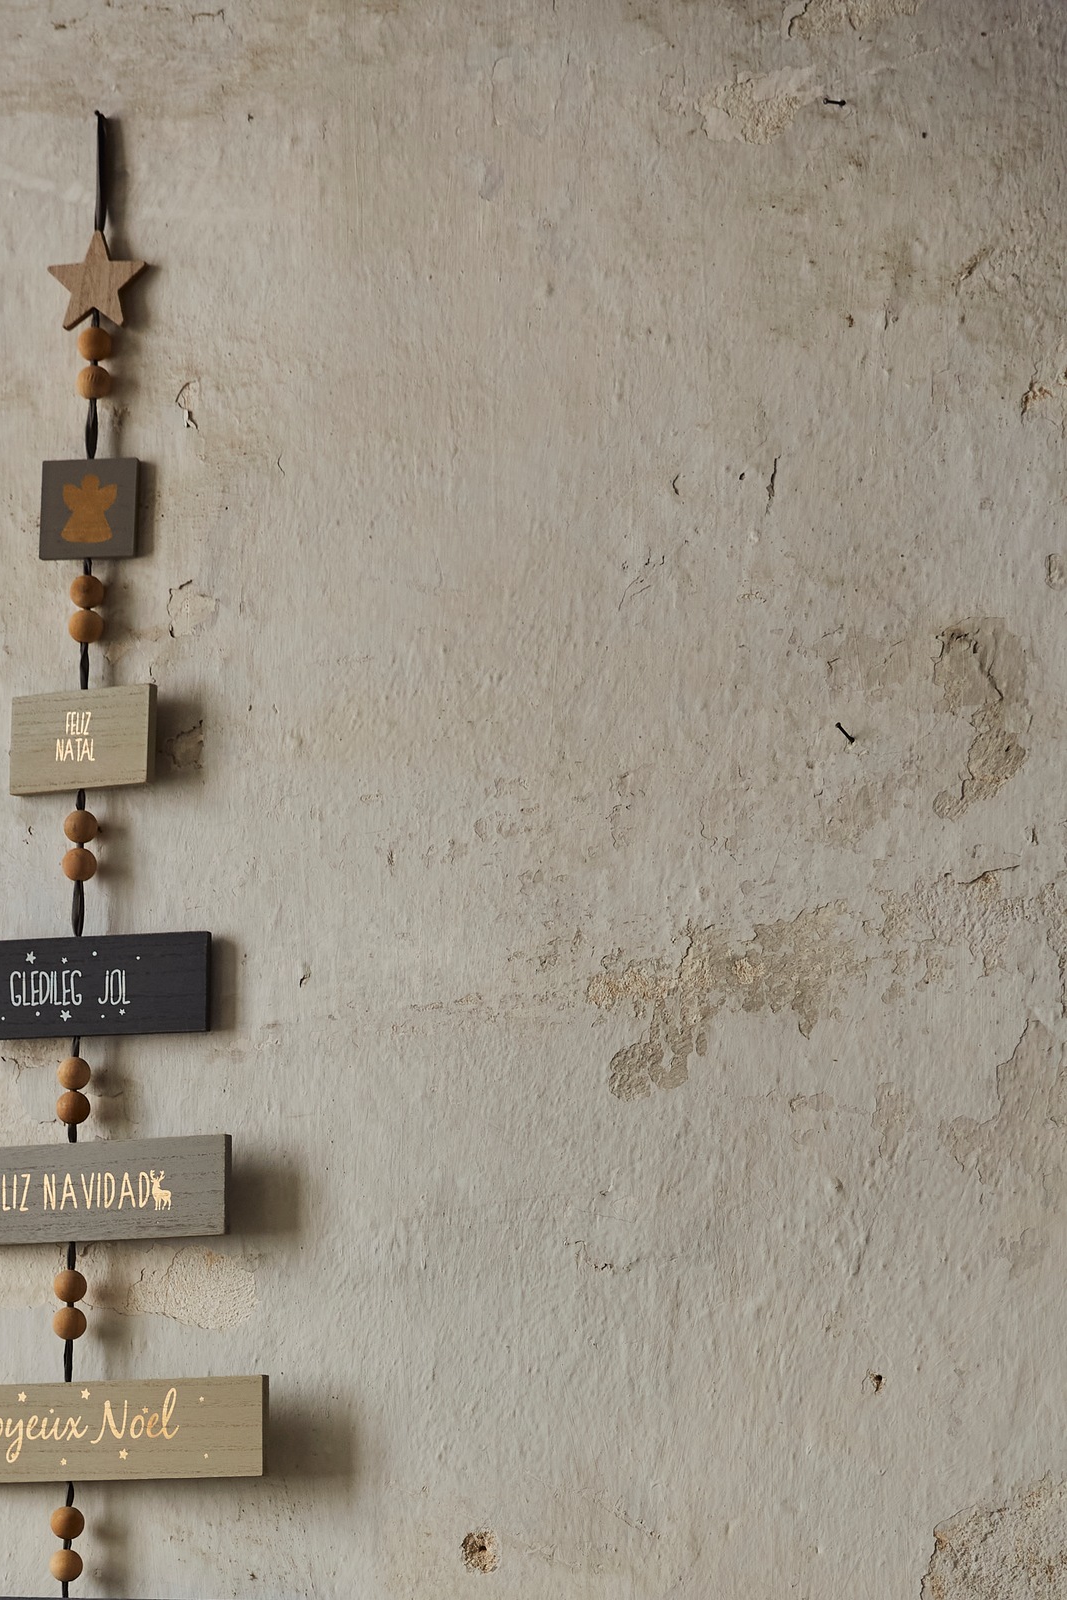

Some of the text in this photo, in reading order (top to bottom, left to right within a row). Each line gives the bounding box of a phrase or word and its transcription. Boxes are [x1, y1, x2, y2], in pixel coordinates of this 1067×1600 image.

[65, 711, 91, 735] FELIZ
[55, 738, 95, 761] NATAL
[9, 969, 130, 1006] GLEDILEG JOL
[43, 1171, 151, 1211] NAVIDAD
